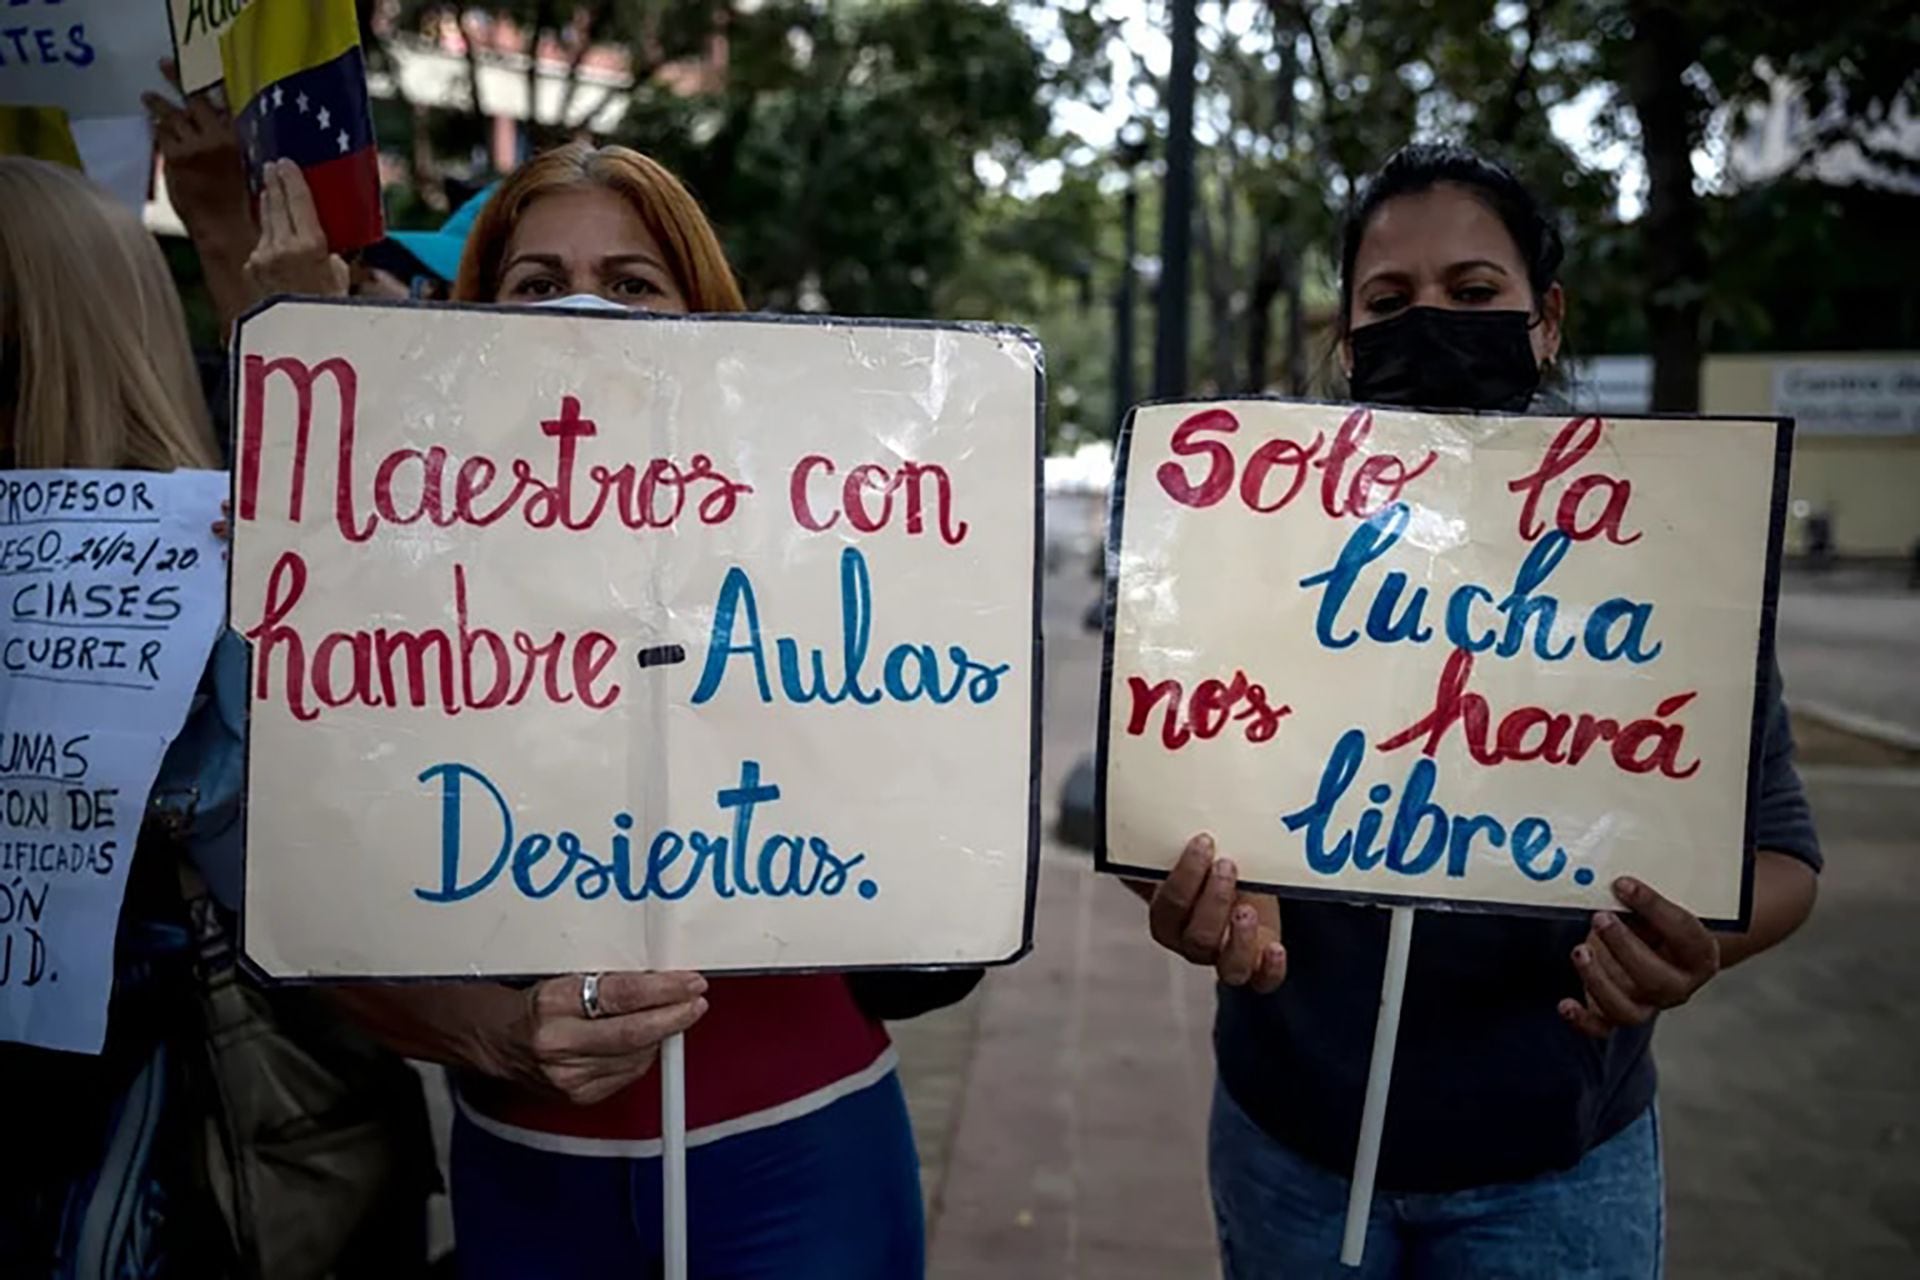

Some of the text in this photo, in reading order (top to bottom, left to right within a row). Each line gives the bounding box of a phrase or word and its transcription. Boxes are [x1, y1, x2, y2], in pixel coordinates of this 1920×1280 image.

[0, 23, 95, 67] TES
[238, 354, 968, 545] Maestros con
[1157, 409, 1642, 545] Solo la
[246, 551, 620, 721] hambre
[690, 546, 1010, 705] Aulas
[1299, 502, 1662, 664] lucha
[3, 636, 162, 681] CUBRIR
[1127, 647, 1701, 779] nos hará
[0, 789, 119, 831] ON DE
[0, 841, 117, 875] IFICADAS
[414, 759, 878, 902] Desiertas.
[1280, 728, 1596, 886] libre.
